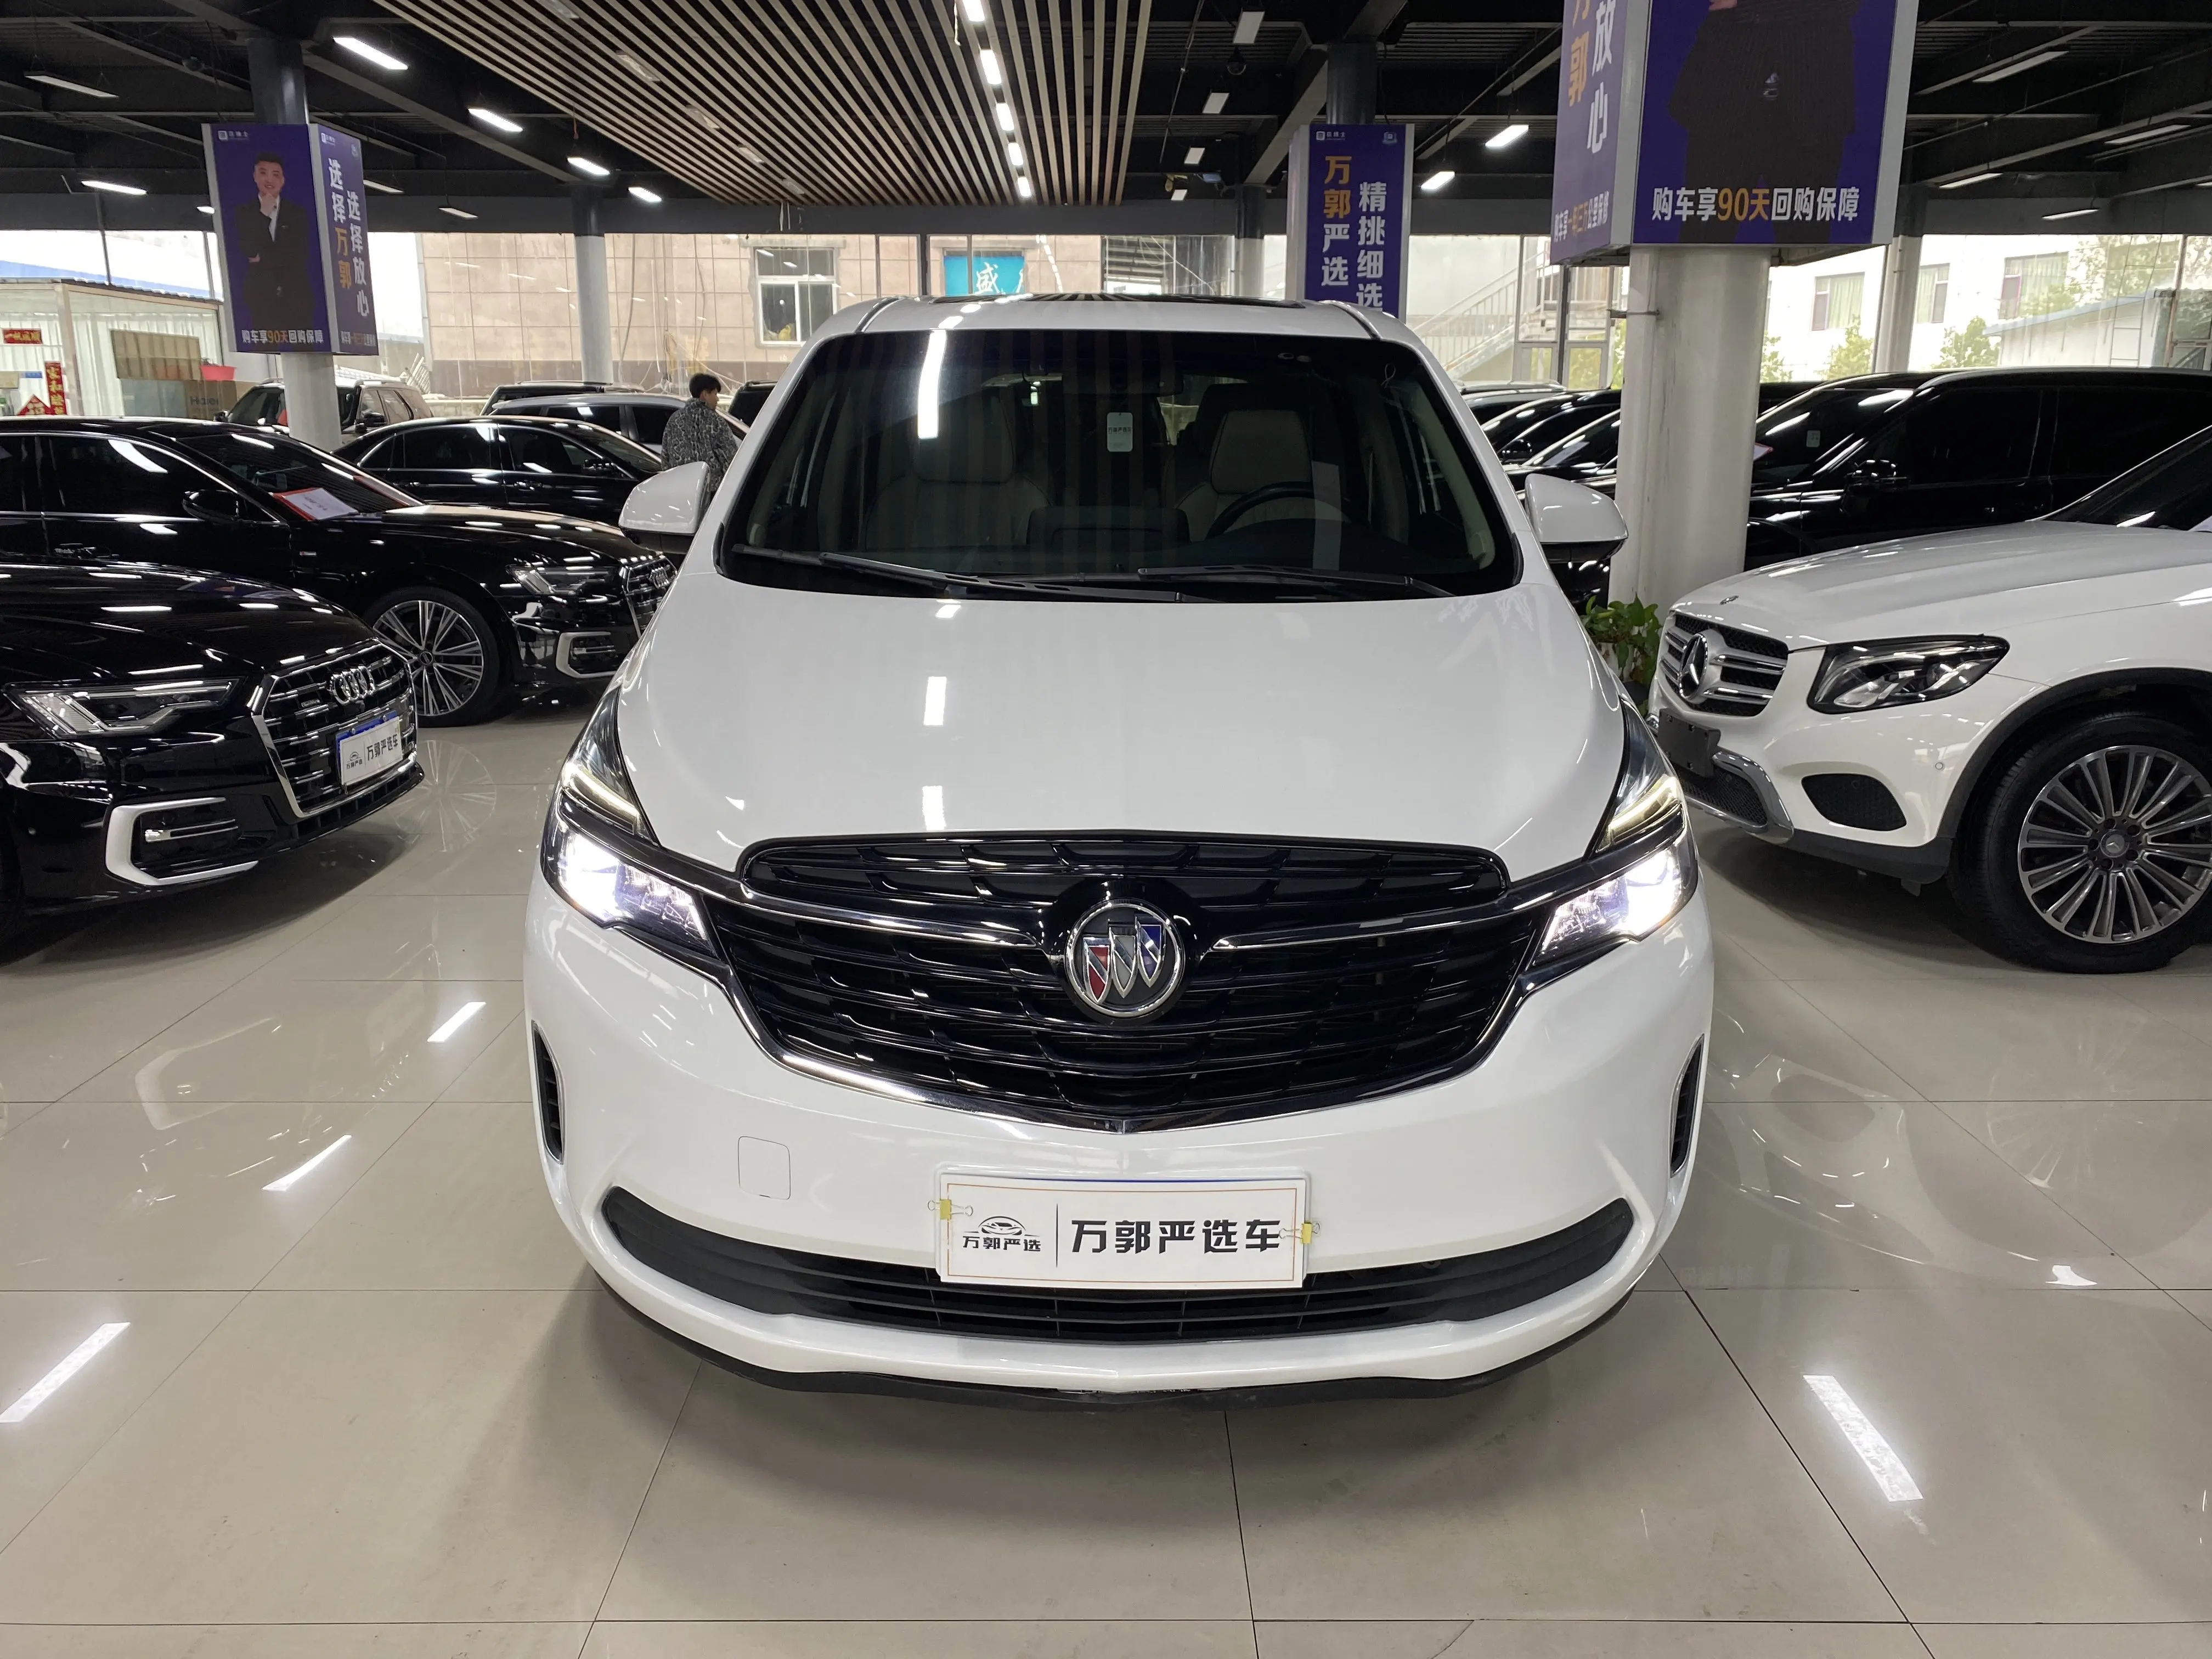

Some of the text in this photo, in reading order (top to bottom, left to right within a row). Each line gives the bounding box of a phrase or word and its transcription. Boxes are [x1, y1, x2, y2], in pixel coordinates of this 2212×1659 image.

[1587, 0, 1616, 154] 放心
[328, 158, 352, 289] 选择万郭
[1321, 156, 1352, 286] 万郭严选
[1651, 187, 1860, 222] 购车享90天回购保障
[347, 190, 370, 317] 选择放心
[1356, 182, 1387, 312] 精挑细选
[241, 329, 324, 344] 购车享90天回购保障
[367, 734, 398, 761] 万郭严选车
[962, 1235, 1041, 1252] 万郭严选
[1071, 1219, 1280, 1254] 万郭严选车
